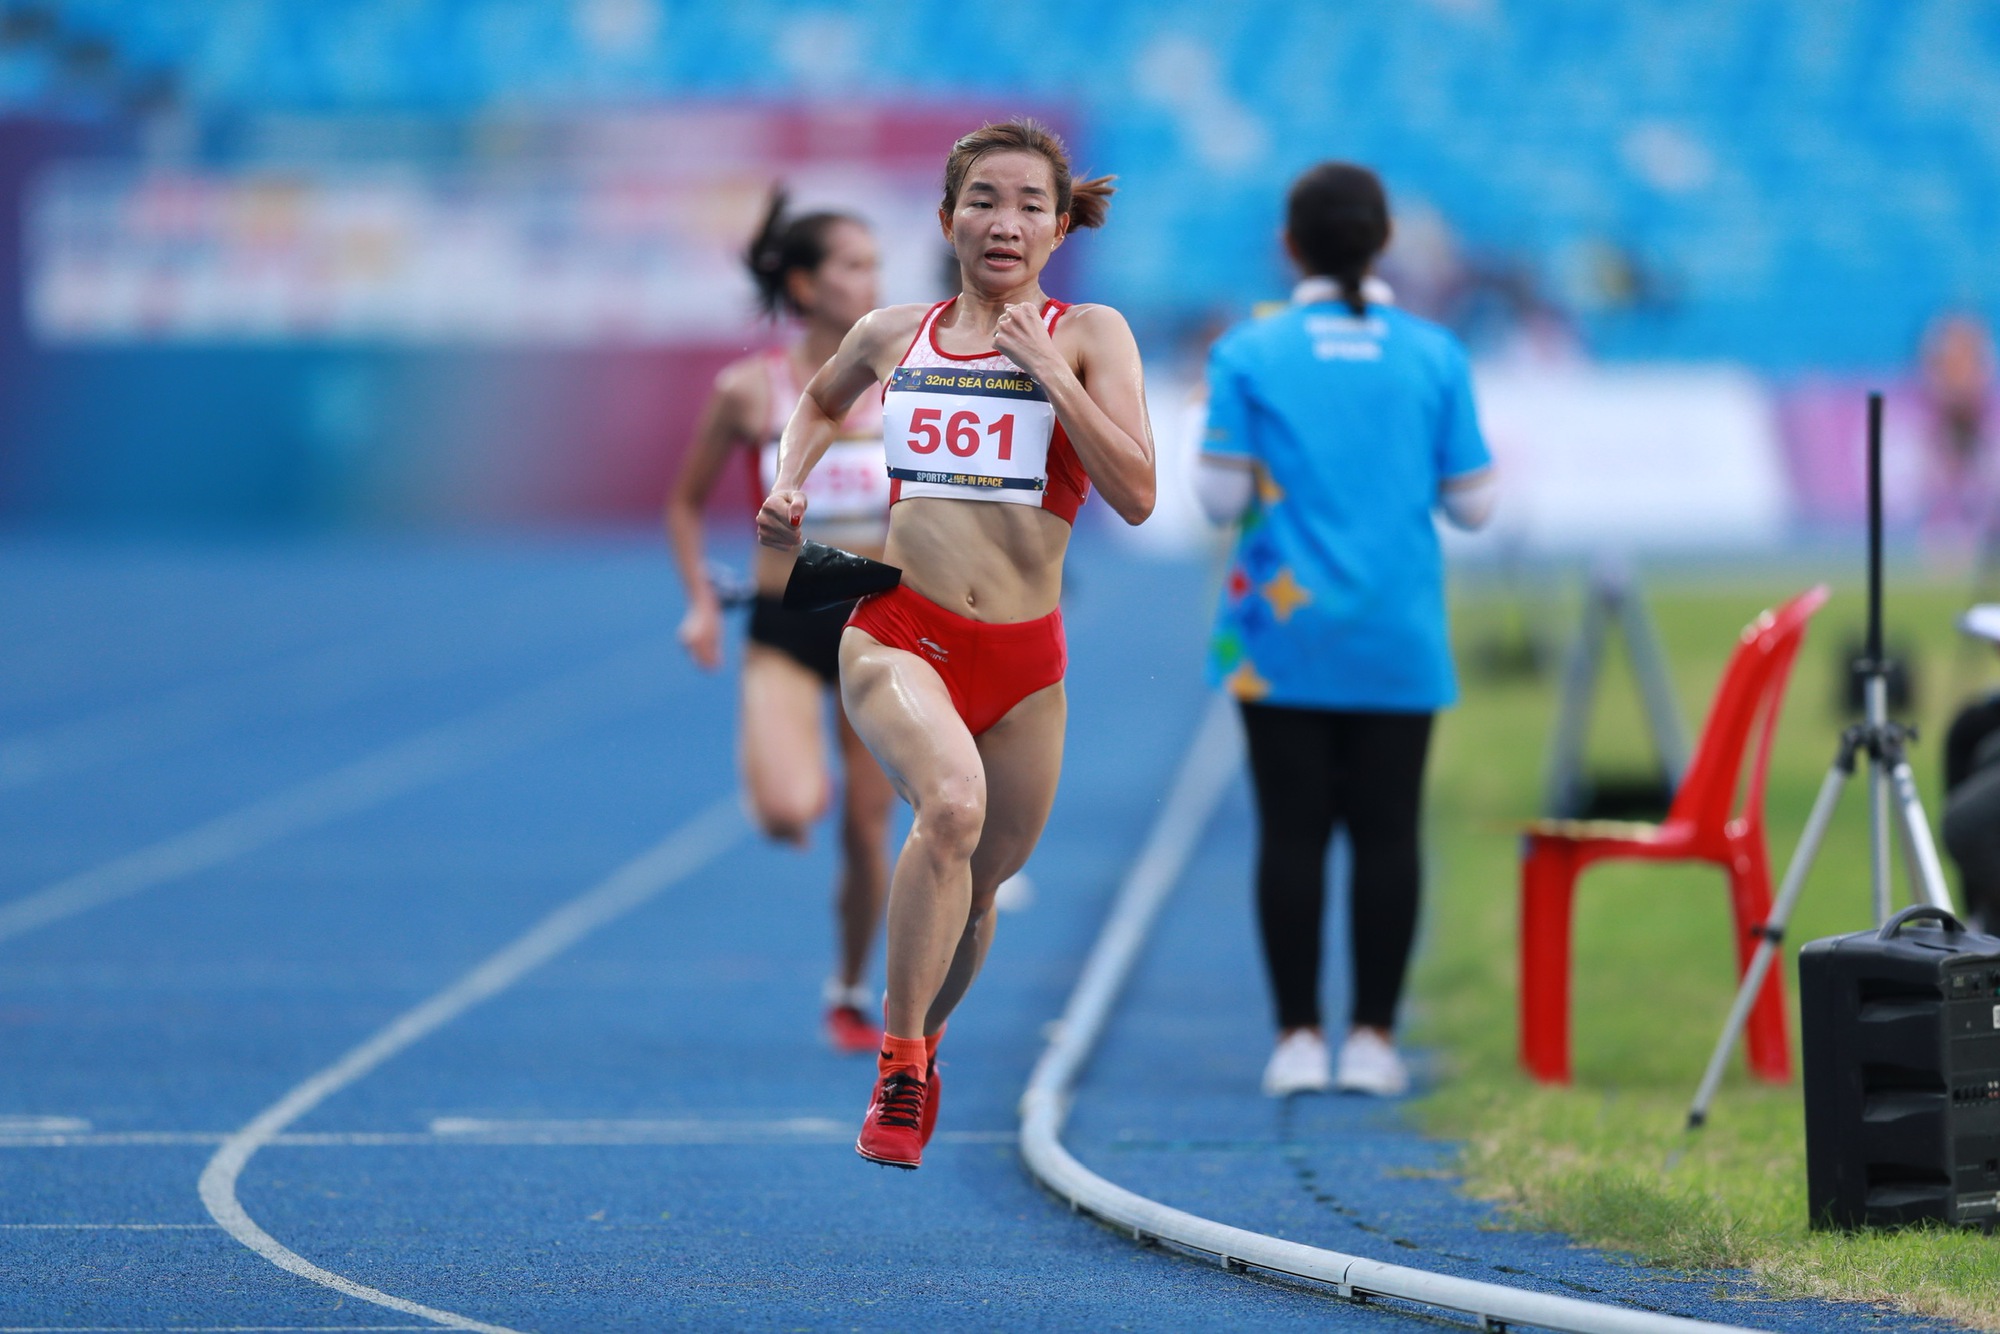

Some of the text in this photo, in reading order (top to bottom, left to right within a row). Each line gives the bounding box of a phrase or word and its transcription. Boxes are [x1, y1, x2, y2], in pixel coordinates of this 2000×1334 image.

[924, 374, 1033, 392] 32nd SEA GAMES
[906, 408, 1015, 460] 561
[916, 472, 947, 484] SPORTS
[977, 476, 1003, 488] PEACE
